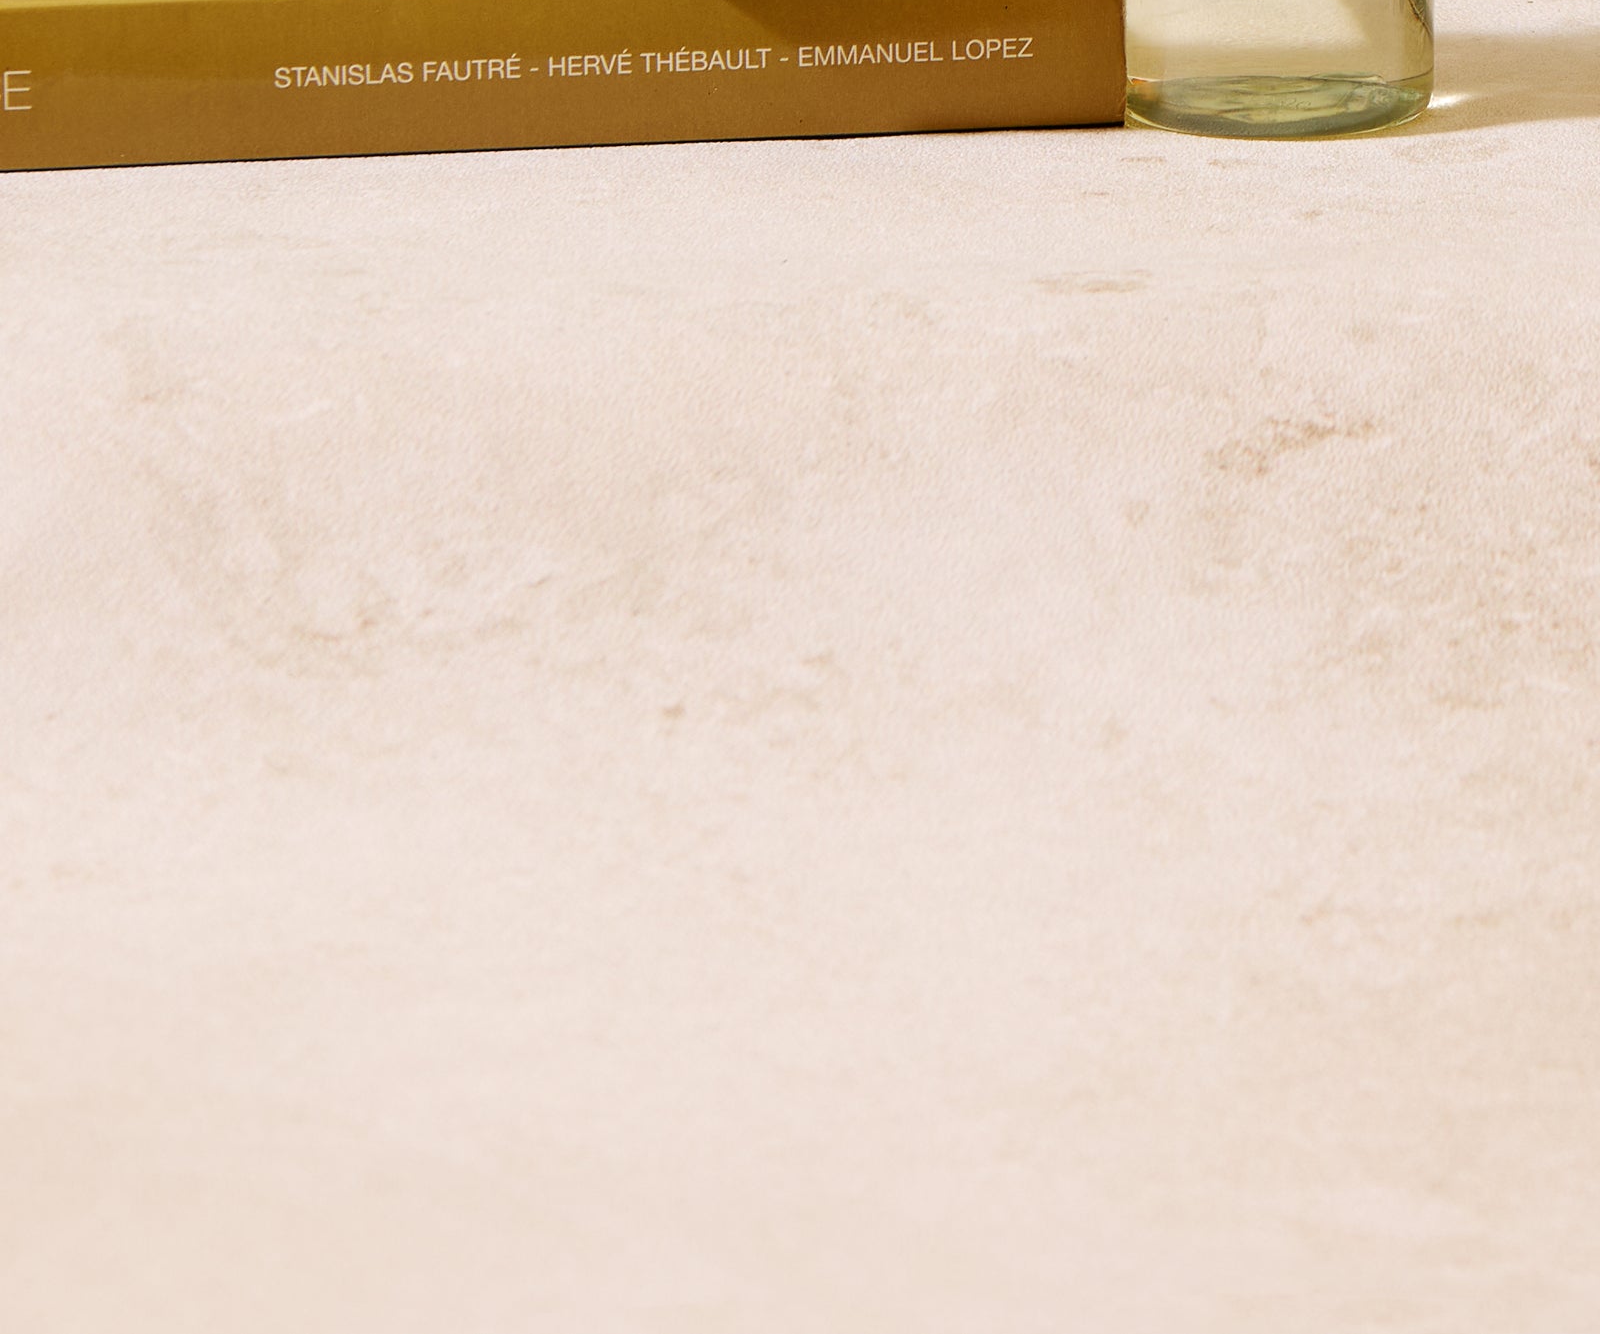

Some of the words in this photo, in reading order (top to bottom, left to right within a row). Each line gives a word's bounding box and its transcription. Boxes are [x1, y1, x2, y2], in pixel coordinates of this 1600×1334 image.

[274, 61, 414, 89] STANISLAS
[423, 53, 522, 82] FAUTRÉ
[549, 49, 633, 77] HERVÉ
[639, 46, 772, 73] THÉBAULT
[799, 41, 943, 67] EMMANUEL
[951, 37, 1034, 61] LOPEZ
